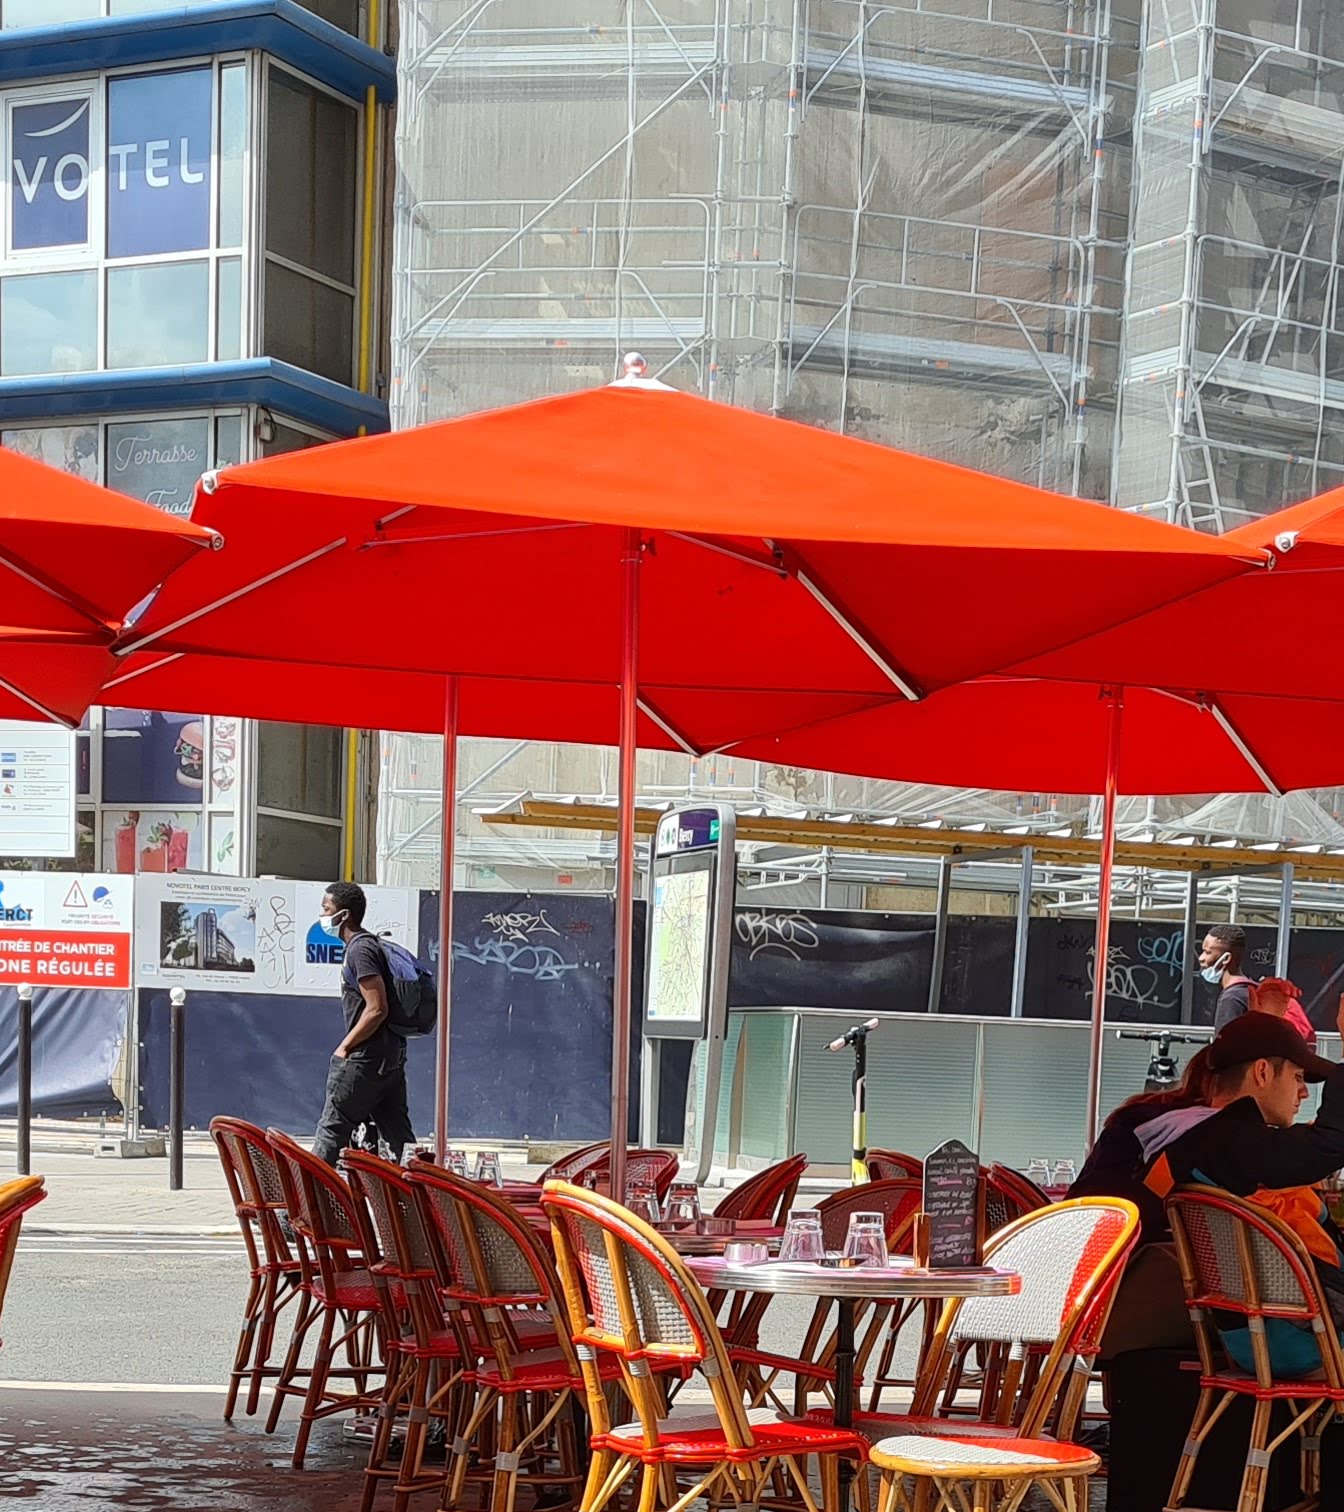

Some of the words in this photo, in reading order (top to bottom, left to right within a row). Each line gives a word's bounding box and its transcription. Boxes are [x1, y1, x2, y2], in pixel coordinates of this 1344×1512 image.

[114, 434, 198, 472] Terrasse
[34, 942, 51, 953] DE
[53, 942, 115, 955] CHANTIER
[37, 956, 116, 977] RÉGULÉE
